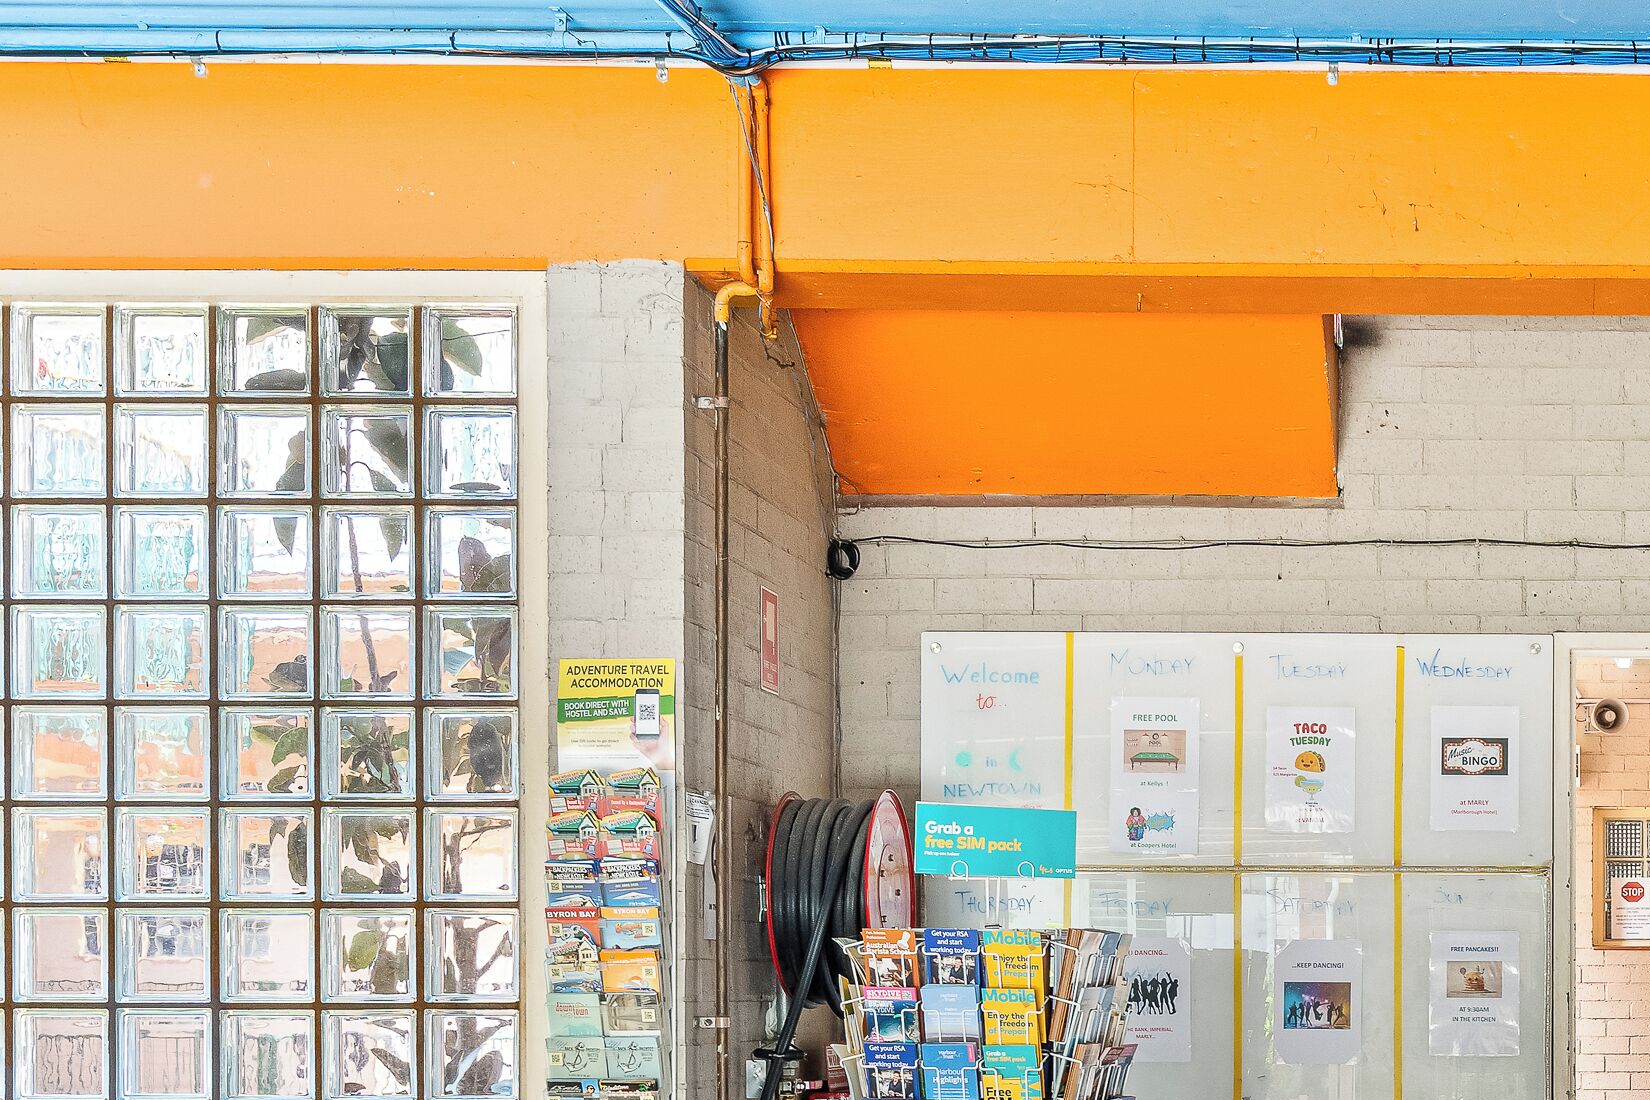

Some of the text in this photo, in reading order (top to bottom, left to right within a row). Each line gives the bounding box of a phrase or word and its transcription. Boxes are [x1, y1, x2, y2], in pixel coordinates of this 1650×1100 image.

[1111, 649, 1195, 676] MONDAY
[1269, 654, 1348, 679] TUESDAY
[1417, 649, 1513, 678] WEDNESDAY
[567, 665, 669, 676] ADVENTURE TRAVEL
[940, 662, 1040, 684] Welcome
[570, 678, 663, 688] ACCOMMODATION
[564, 700, 629, 711] BOOK DIRECT WITH
[565, 707, 629, 718] HOSTEL AND SAVE.
[1132, 714, 1178, 722] FREE POOL
[1294, 723, 1327, 734] TACO
[1290, 737, 1331, 746] TUESDAY
[1447, 746, 1473, 761] Music
[986, 756, 997, 767] in
[1462, 756, 1498, 766] BINGO
[943, 782, 1041, 798] NEWTOWN
[925, 820, 974, 836] Grab a
[925, 837, 1022, 853] free SIM pack
[1623, 888, 1643, 896] STOP
[986, 931, 1041, 946] Mobile
[983, 989, 1035, 1002] Mobile
